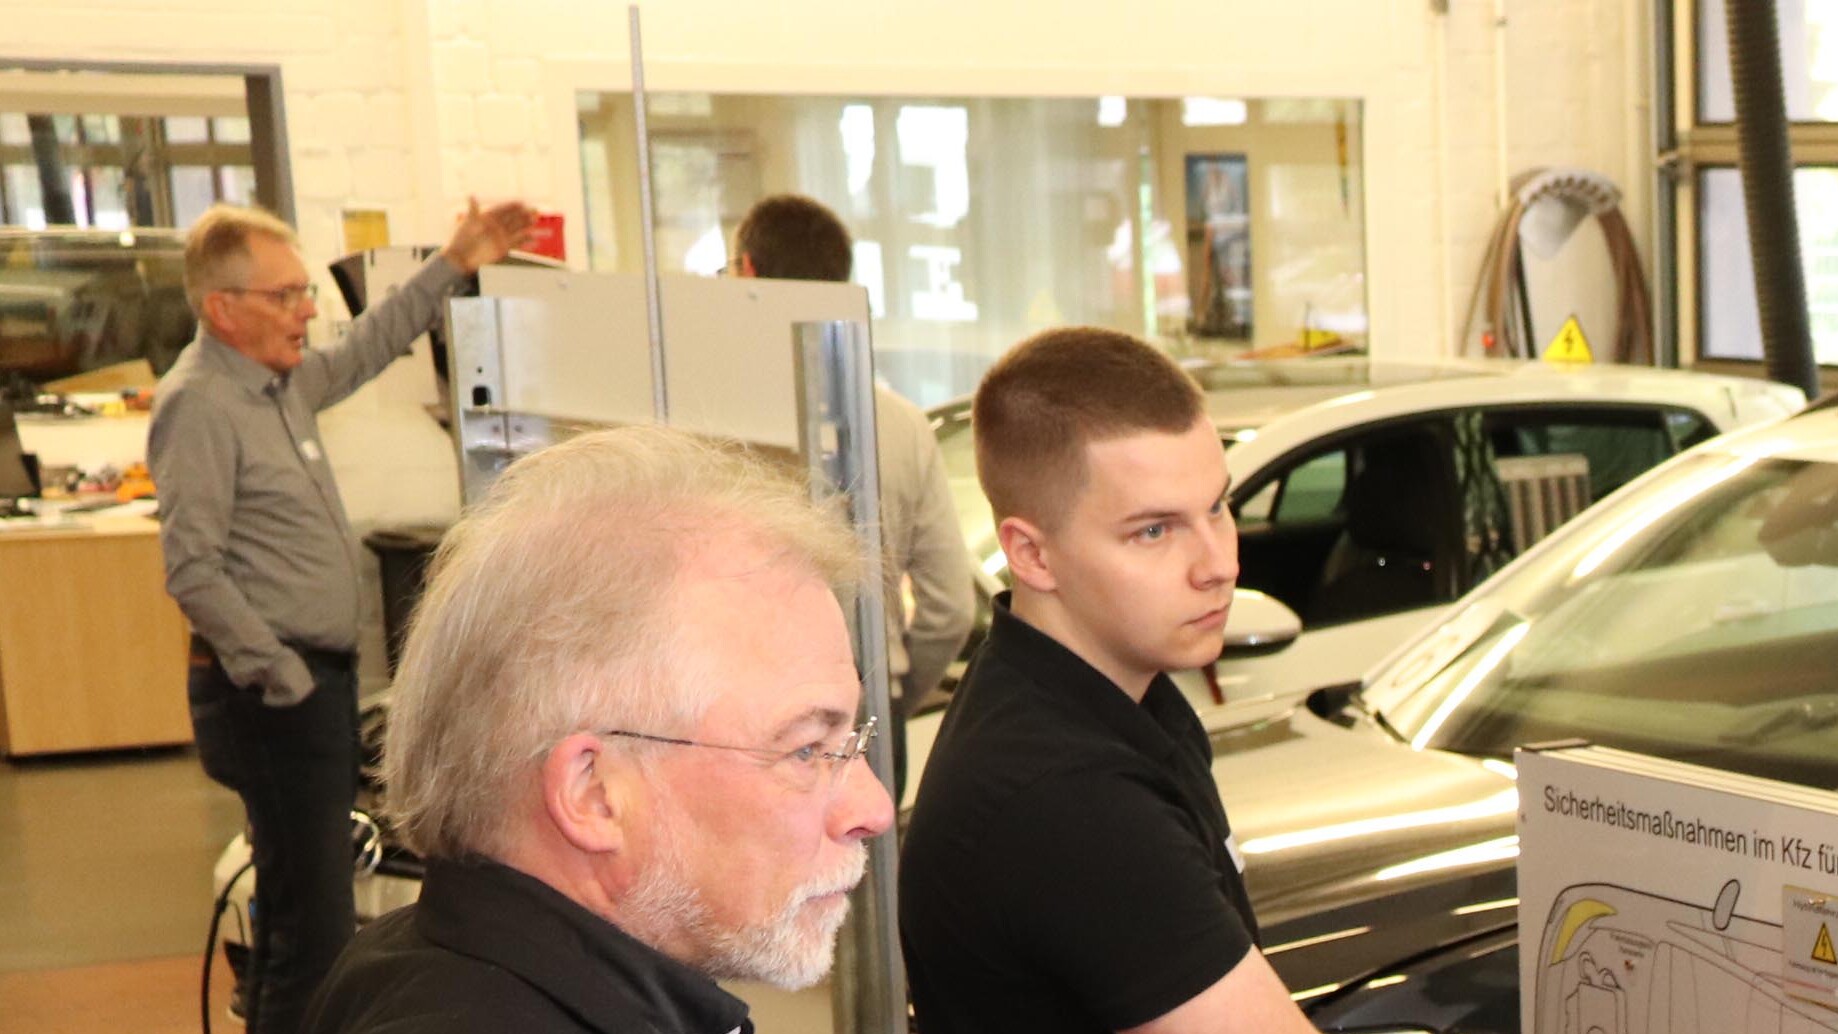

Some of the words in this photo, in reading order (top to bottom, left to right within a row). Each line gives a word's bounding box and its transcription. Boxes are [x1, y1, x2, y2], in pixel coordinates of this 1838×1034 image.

[1543, 784, 1748, 855] Sicherheitsmaßnahmen
[1752, 831, 1776, 862] im
[1781, 836, 1813, 870] Kfz
